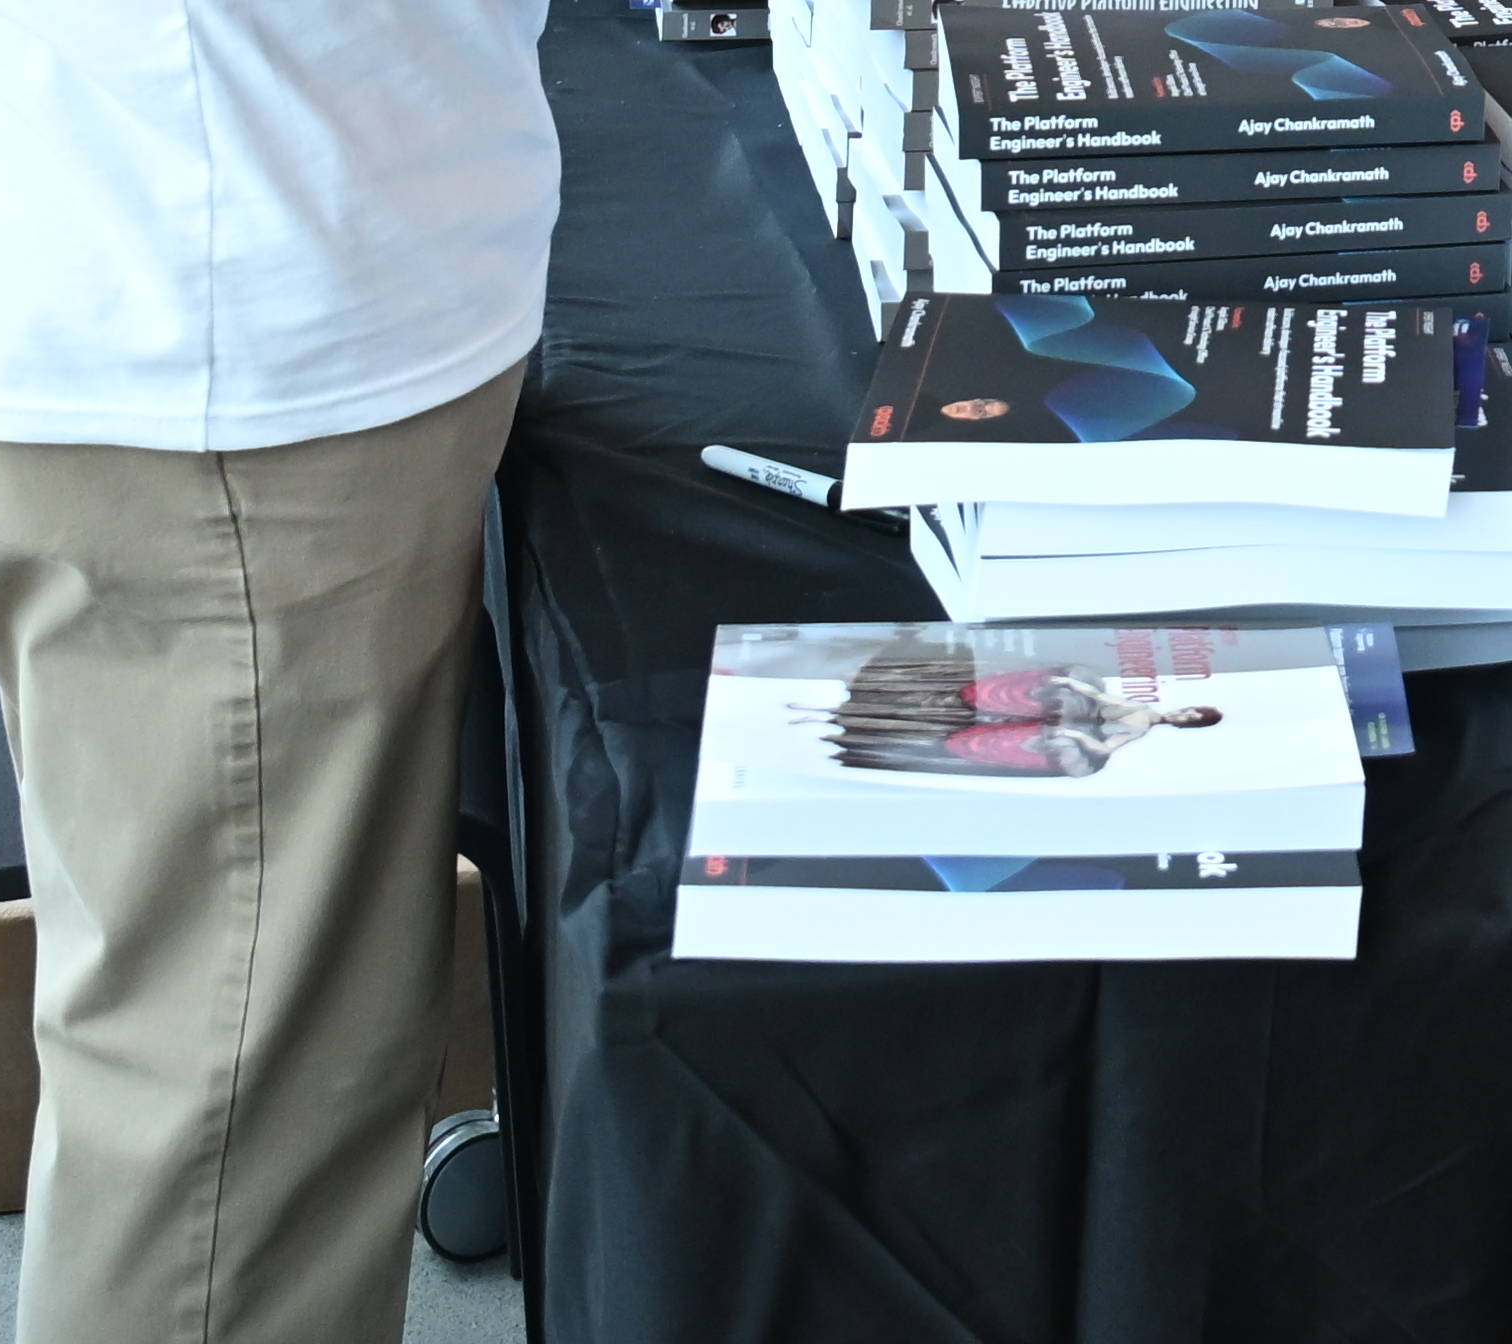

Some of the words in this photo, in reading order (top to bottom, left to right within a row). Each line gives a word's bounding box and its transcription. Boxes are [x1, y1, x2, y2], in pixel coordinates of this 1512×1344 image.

[989, 117, 1021, 131] The
[1024, 115, 1098, 130] Platform
[1238, 119, 1272, 136] Ajay
[1274, 115, 1375, 132] Chankramath
[990, 134, 1074, 153] Engineer's
[1077, 130, 1161, 147] Handbook
[1008, 170, 1040, 185] The
[1042, 167, 1116, 184] Platform
[1254, 171, 1288, 188] Ajay
[1289, 167, 1389, 184] Chankramath
[1008, 187, 1092, 207] Engineer's
[1095, 183, 1178, 200] Handbook
[1026, 226, 1057, 240] The
[1060, 222, 1133, 239] Platform
[1270, 224, 1303, 240] Ajay
[1305, 217, 1403, 235] Chankramath
[1026, 242, 1109, 262] Engineer's
[1112, 236, 1195, 255] Handbook
[1020, 279, 1051, 293] The
[1054, 276, 1126, 291] Platform
[1264, 276, 1297, 292] Ajay
[1299, 269, 1396, 287] Chankramath
[1363, 310, 1398, 328] The
[1361, 329, 1397, 385] Platform
[1306, 365, 1344, 438] Handbook
